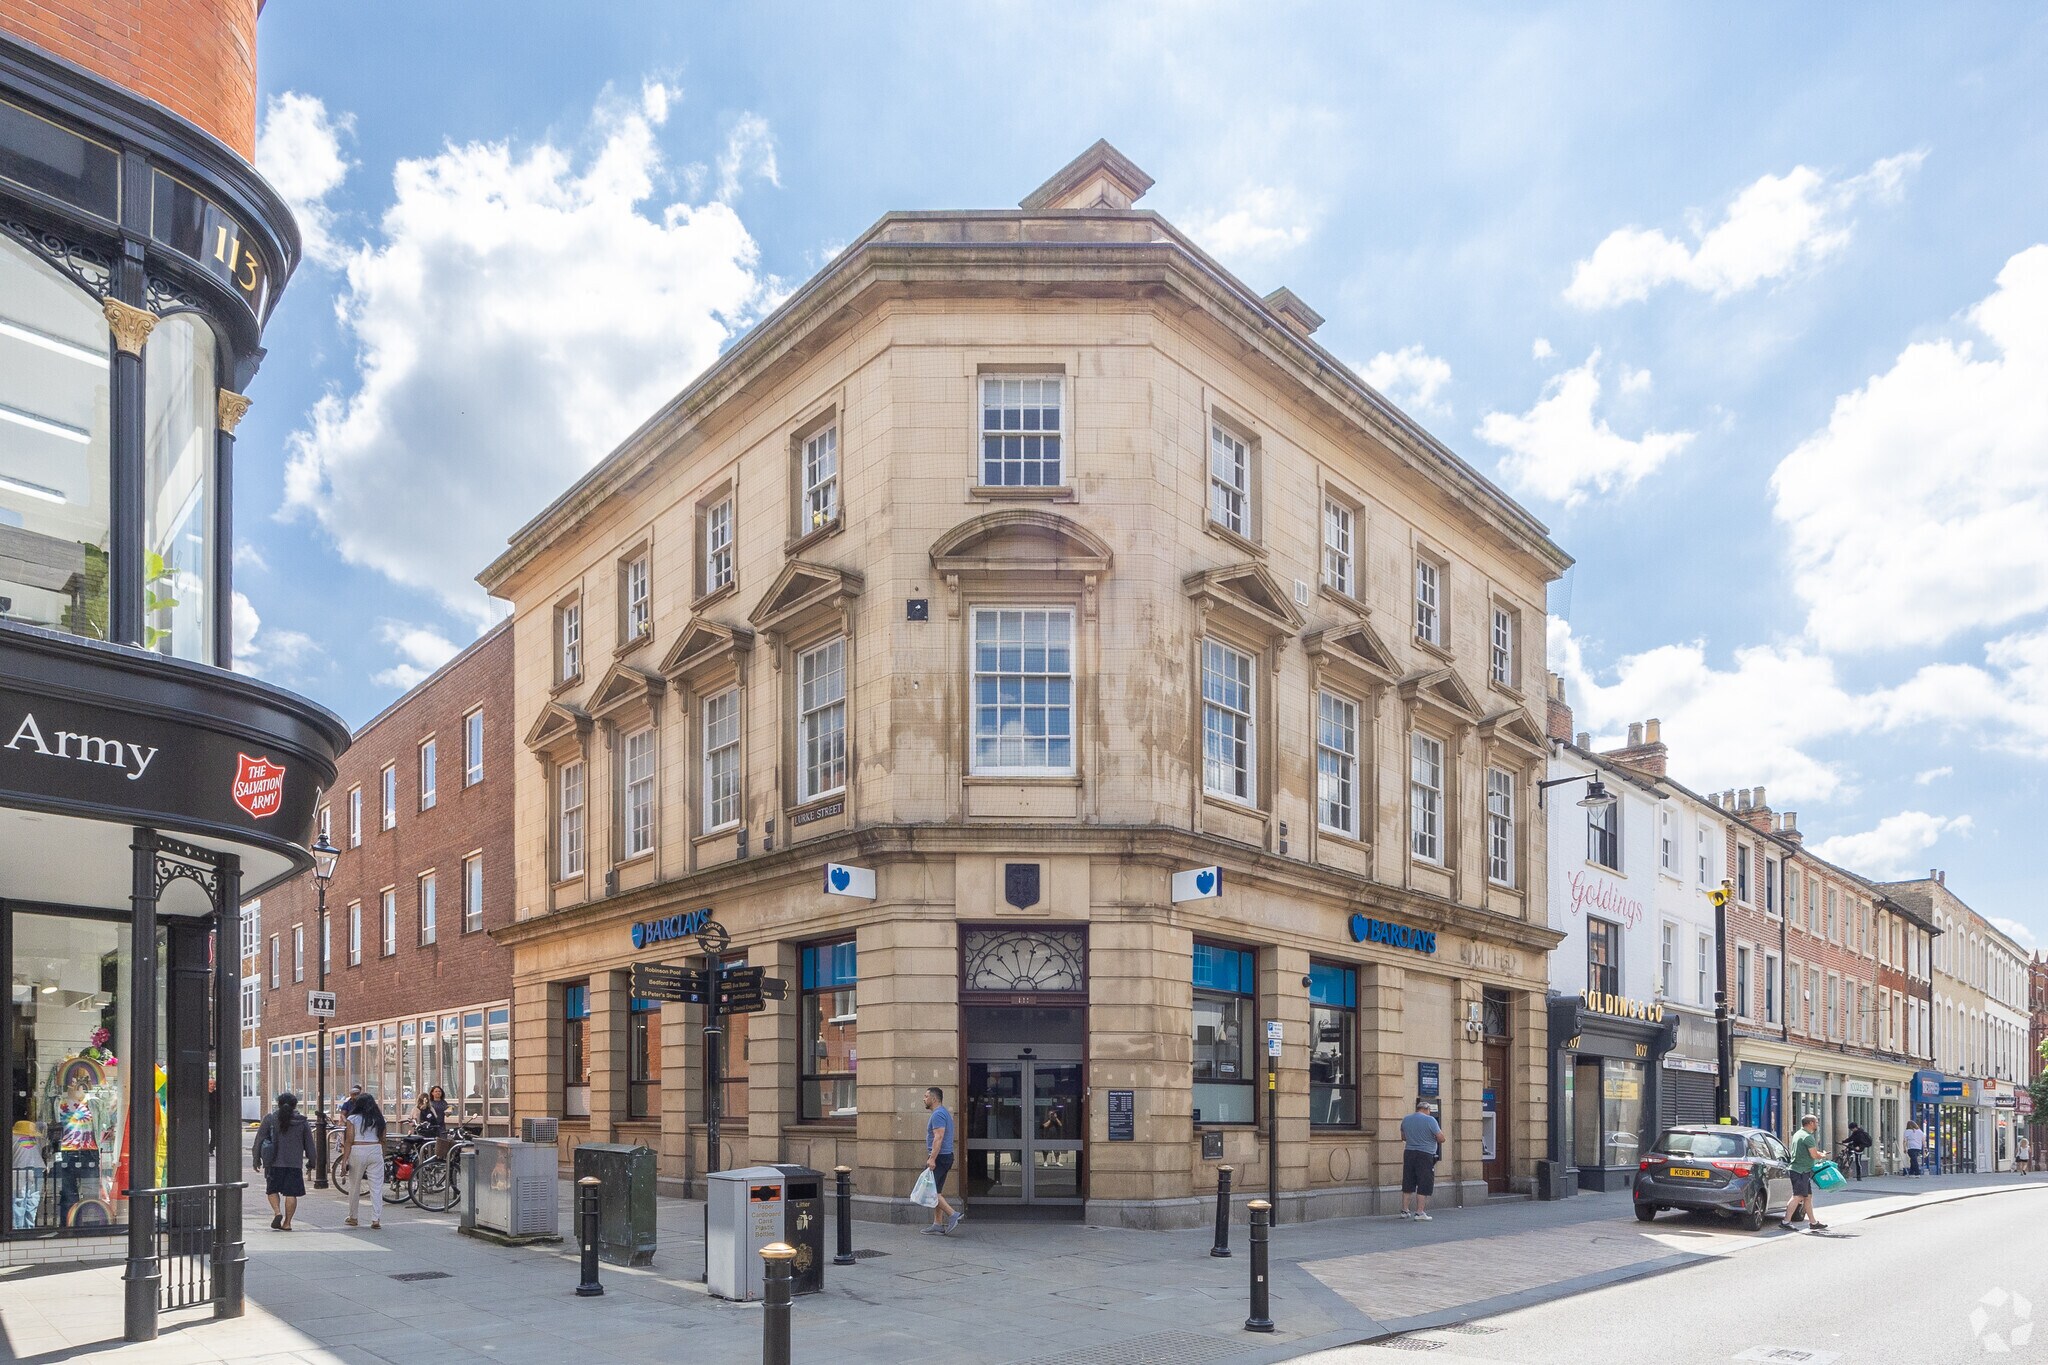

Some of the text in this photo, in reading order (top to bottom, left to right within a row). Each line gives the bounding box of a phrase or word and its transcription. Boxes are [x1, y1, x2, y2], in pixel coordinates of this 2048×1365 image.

[214, 225, 259, 291] 113
[4, 712, 159, 780] Army
[248, 765, 266, 779] THE
[236, 773, 281, 798] SALVATION
[250, 793, 277, 811] ARMY
[794, 803, 842, 825] LURKE STREET
[1567, 870, 1644, 930] Goldings
[645, 908, 710, 943] BARCLAYS
[1370, 919, 1436, 953] BARCLAYS
[703, 944, 722, 953] STREET
[644, 966, 668, 975] Robinson
[648, 978, 681, 988] Bedford Park
[1638, 1000, 1645, 1020] &
[1647, 1003, 1663, 1023] CO
[1567, 1035, 1581, 1049] 07
[1635, 1043, 1648, 1057] 107
[1674, 1169, 1706, 1178] KO18 KME
